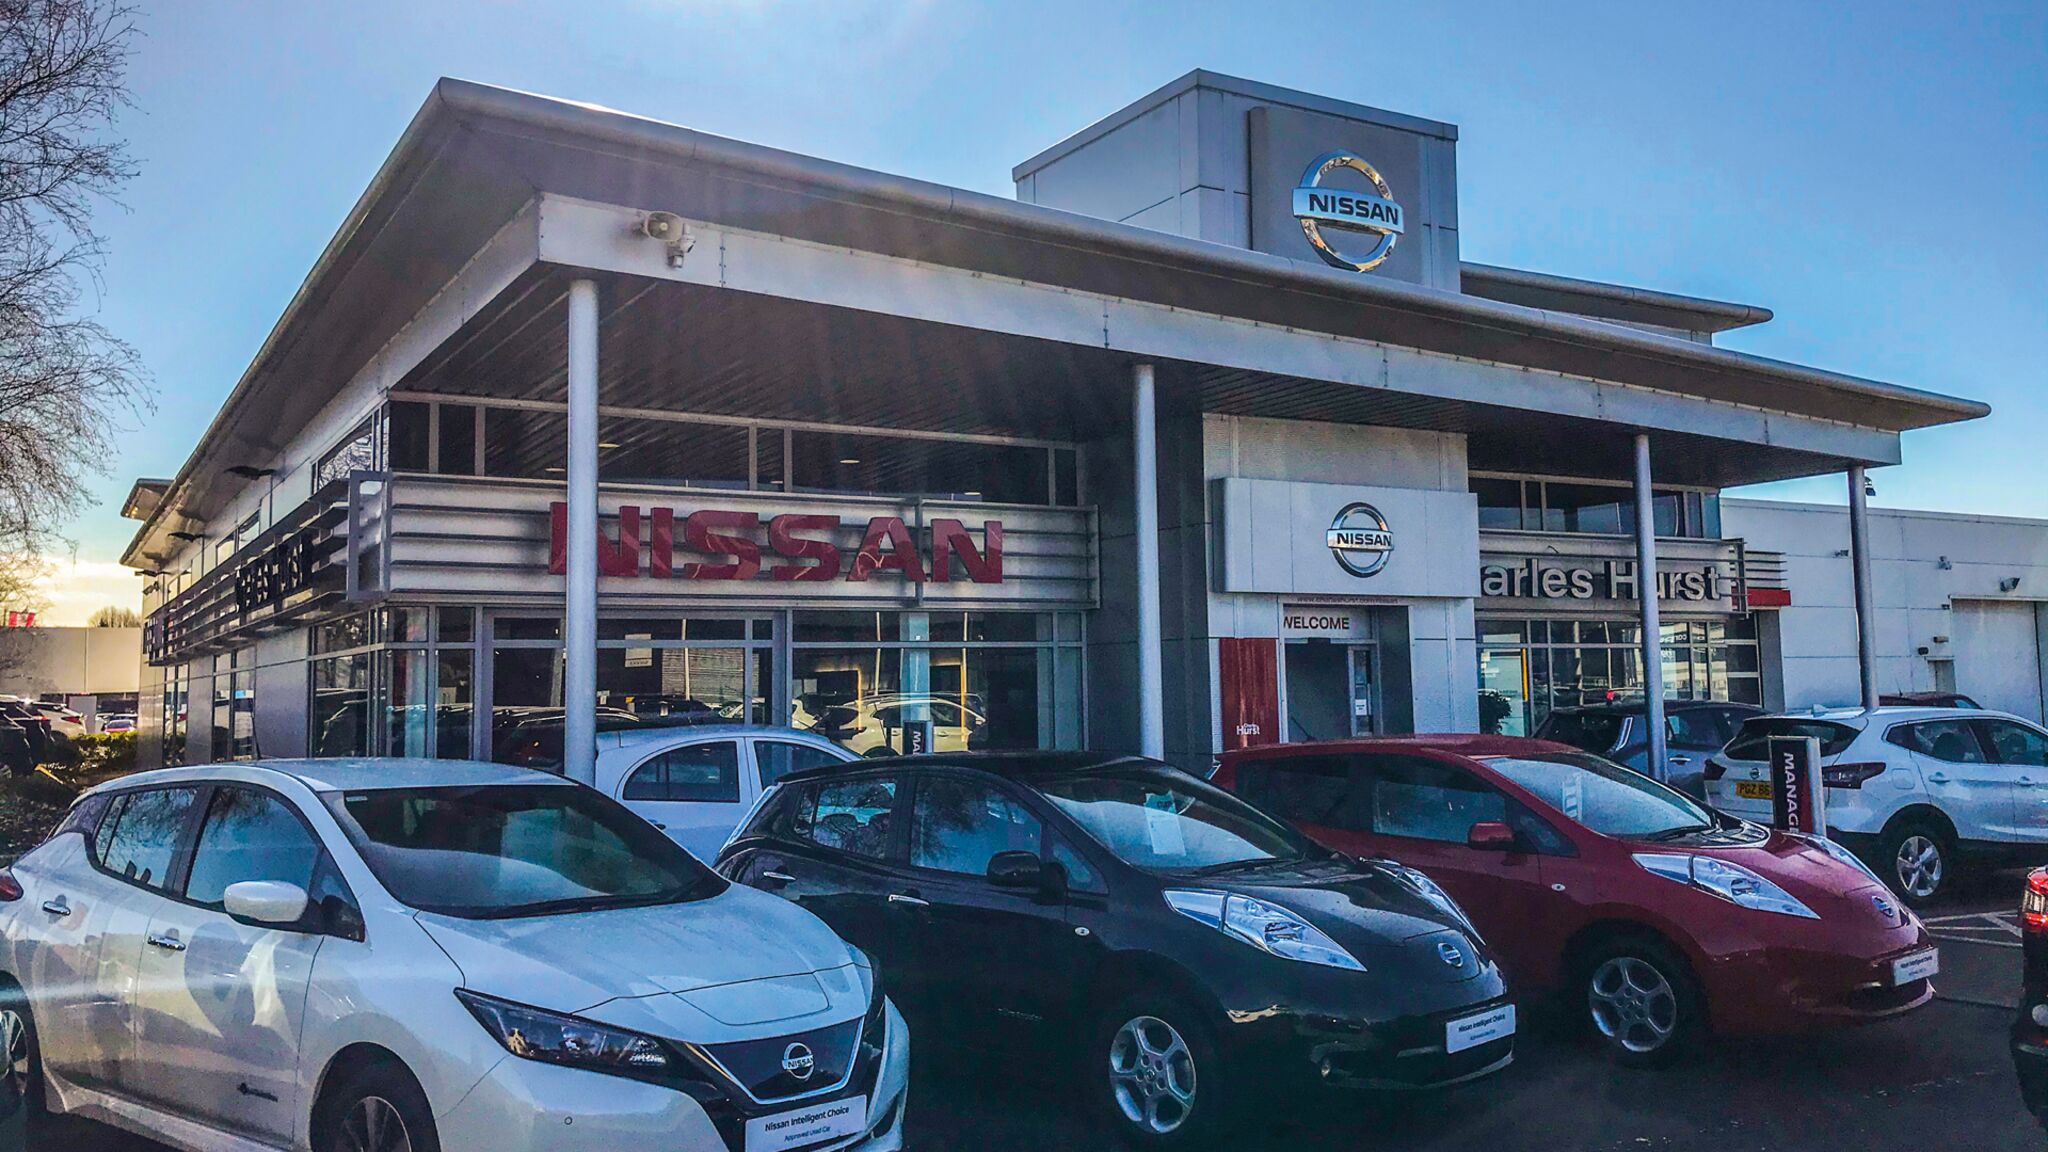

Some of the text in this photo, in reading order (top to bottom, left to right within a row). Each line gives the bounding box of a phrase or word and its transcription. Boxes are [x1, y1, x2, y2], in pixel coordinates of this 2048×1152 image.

[1308, 193, 1399, 225] NISSAN
[549, 501, 1003, 584] NISSAN
[1336, 532, 1392, 547] NISSAN
[764, 1105, 850, 1132] Nissan Intelligent Choice
